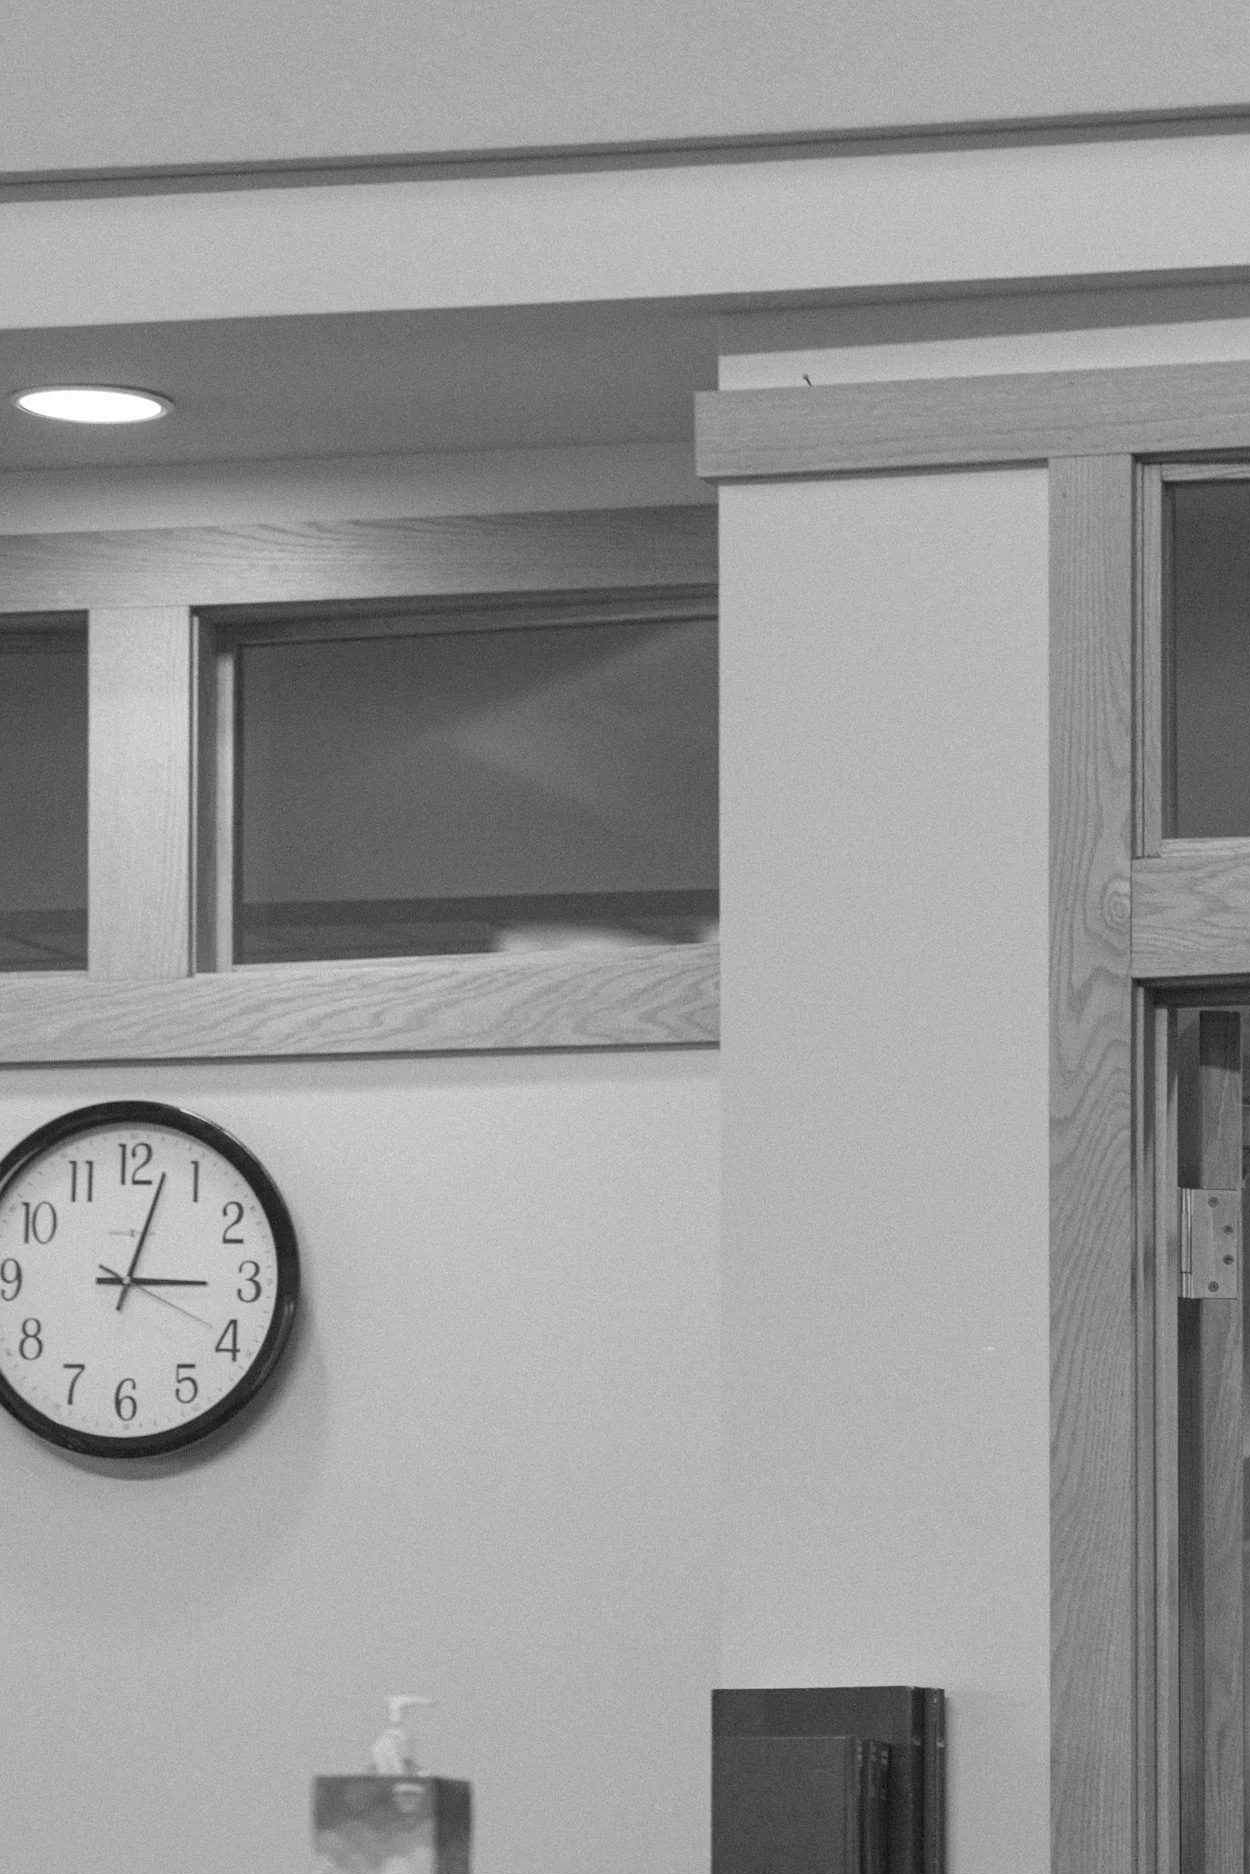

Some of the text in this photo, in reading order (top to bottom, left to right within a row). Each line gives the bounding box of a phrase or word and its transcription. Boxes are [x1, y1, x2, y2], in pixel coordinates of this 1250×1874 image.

[68, 1160, 94, 1203] 11
[118, 1141, 154, 1186] 12
[190, 1160, 200, 1203] 1
[21, 1201, 58, 1244] 10
[222, 1200, 245, 1245] 2
[0, 1258, 23, 1302] 9
[236, 1260, 262, 1303] 3
[18, 1317, 44, 1361] 8
[214, 1318, 241, 1363] 4
[62, 1363, 86, 1406] 7
[114, 1377, 138, 1421] 6
[175, 1363, 199, 1404] 5
